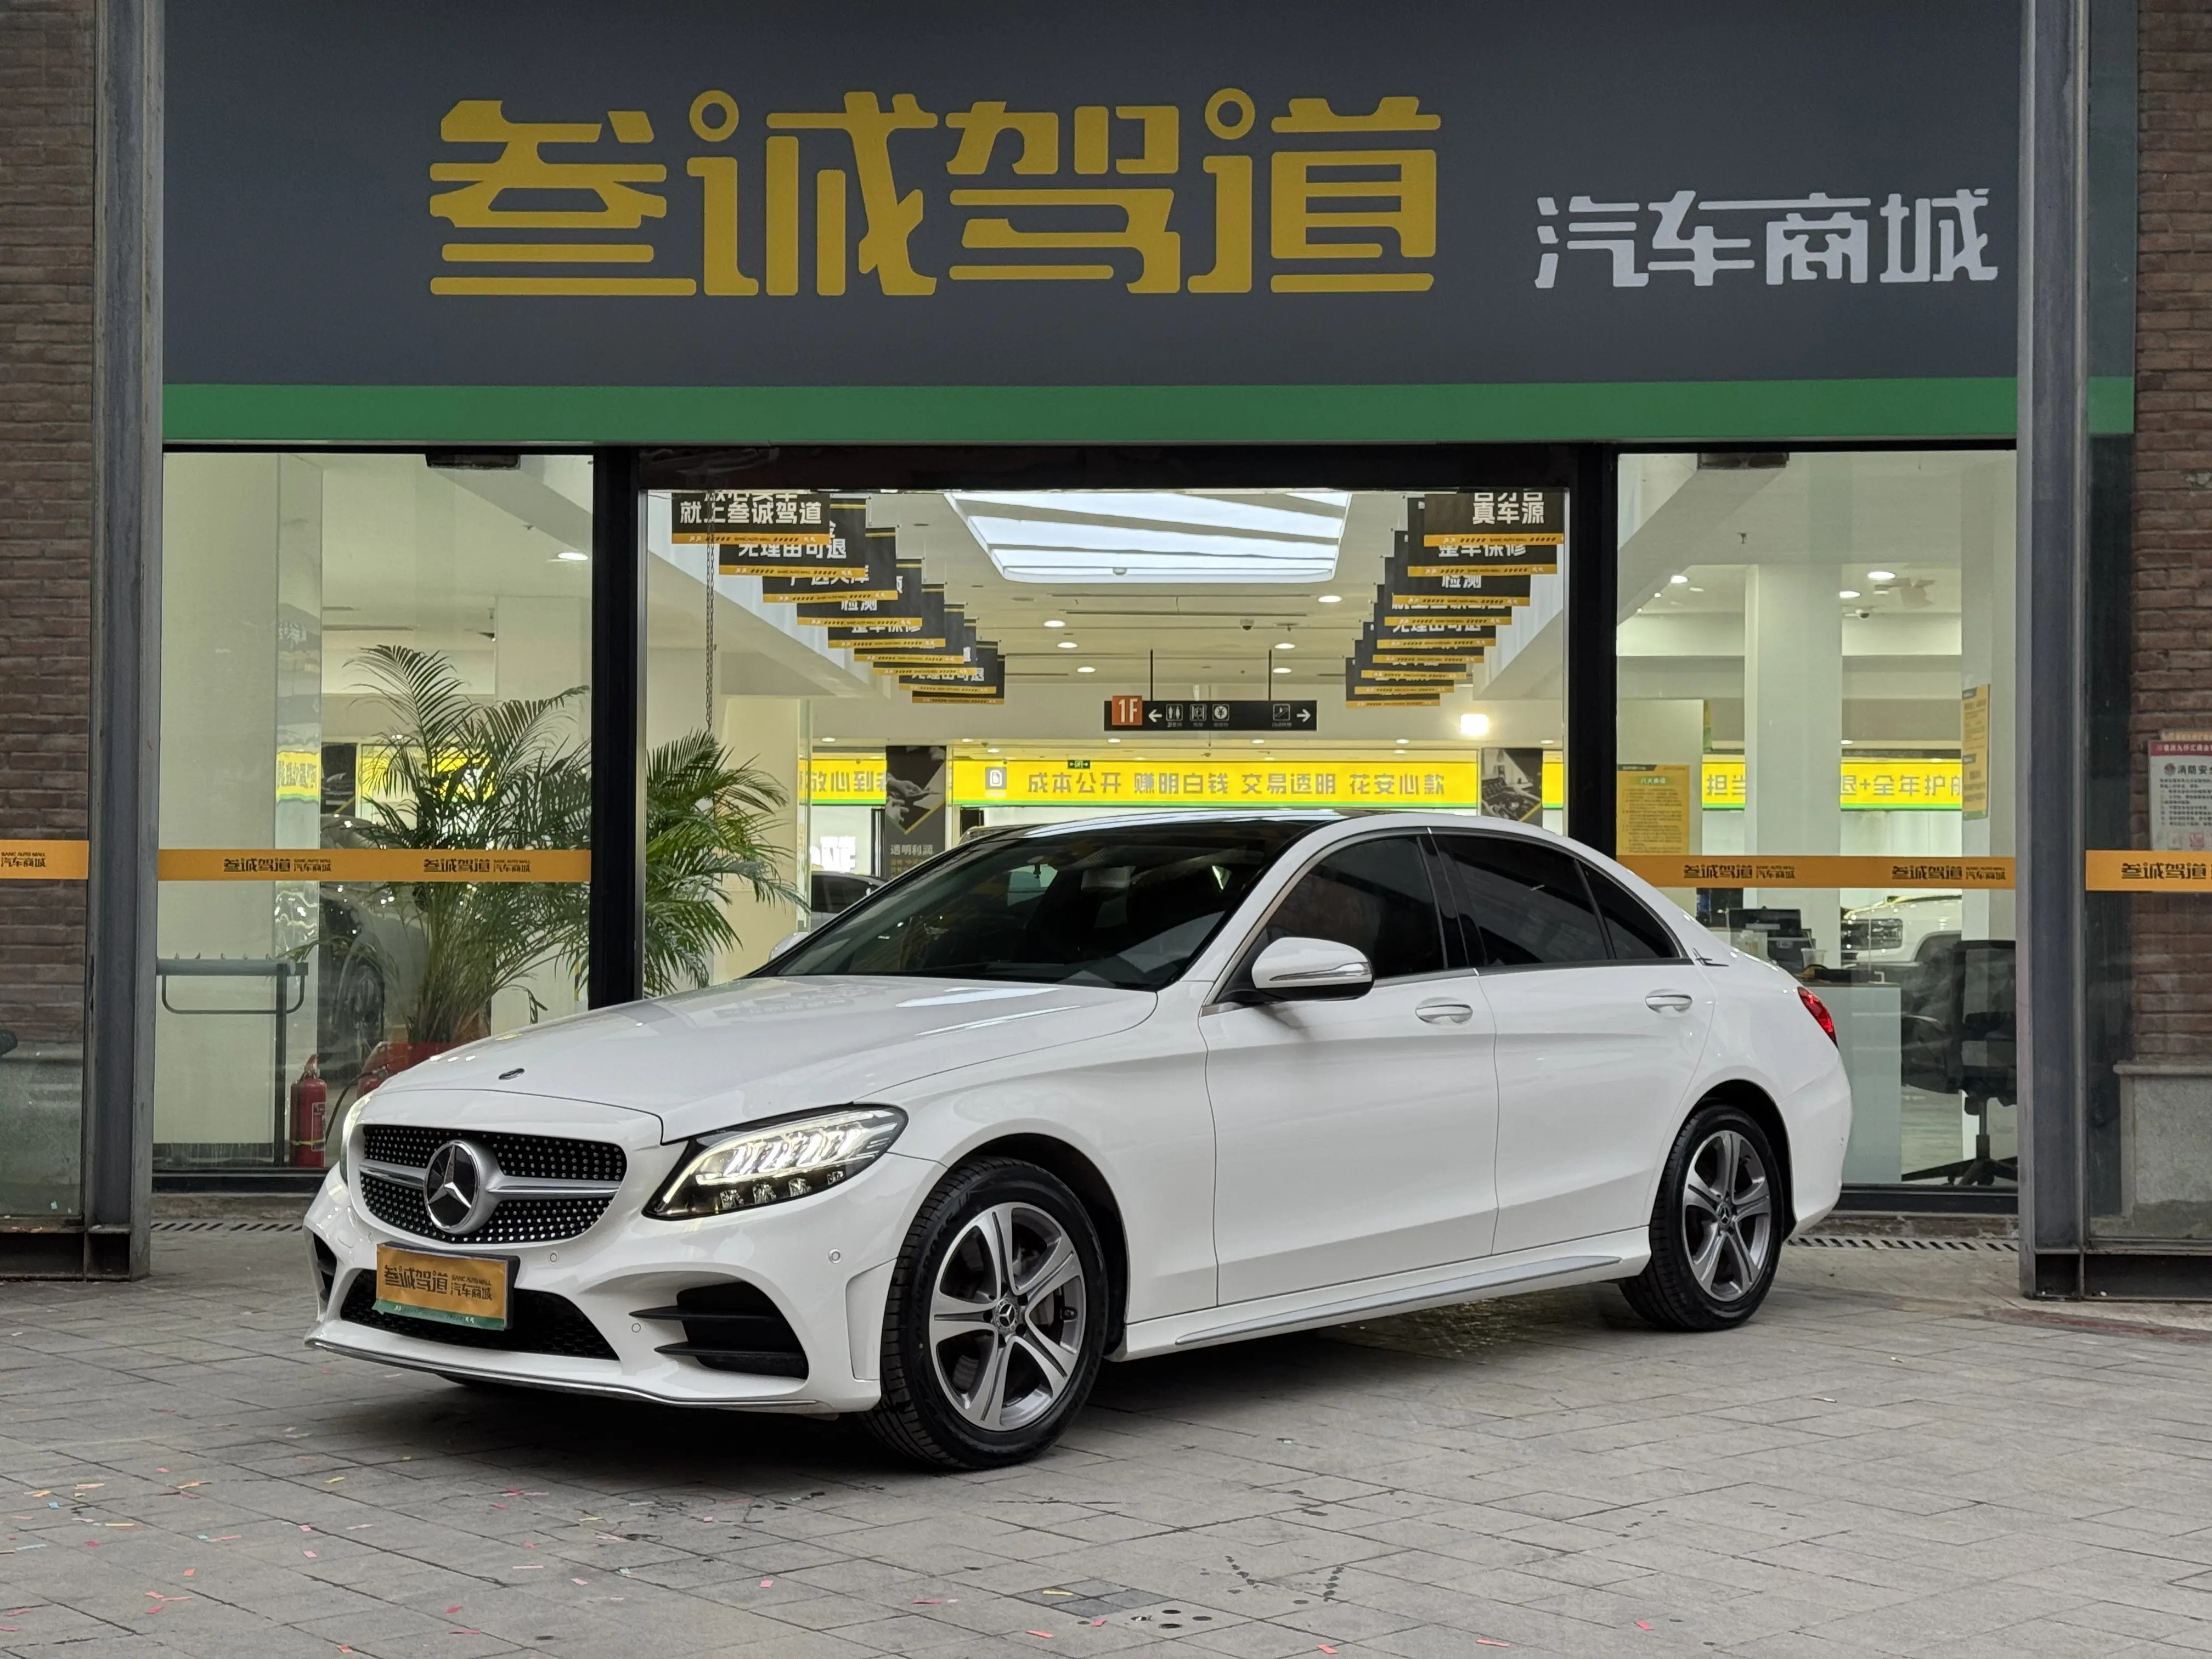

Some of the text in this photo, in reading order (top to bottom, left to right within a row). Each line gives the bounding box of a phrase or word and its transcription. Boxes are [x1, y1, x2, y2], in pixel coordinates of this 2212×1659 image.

[429, 89, 1999, 296] 叁诚驾道 汽车商城
[1472, 501, 1544, 524] 真车源
[1118, 698, 1138, 723] 1F
[1028, 772, 1444, 795] 成本公开 赚明白钱 交易透明 花安心款
[2121, 862, 2207, 879] 叁诚驾道
[385, 1265, 448, 1295] 叁诚驾道
[450, 1282, 493, 1301] 汽车商城
